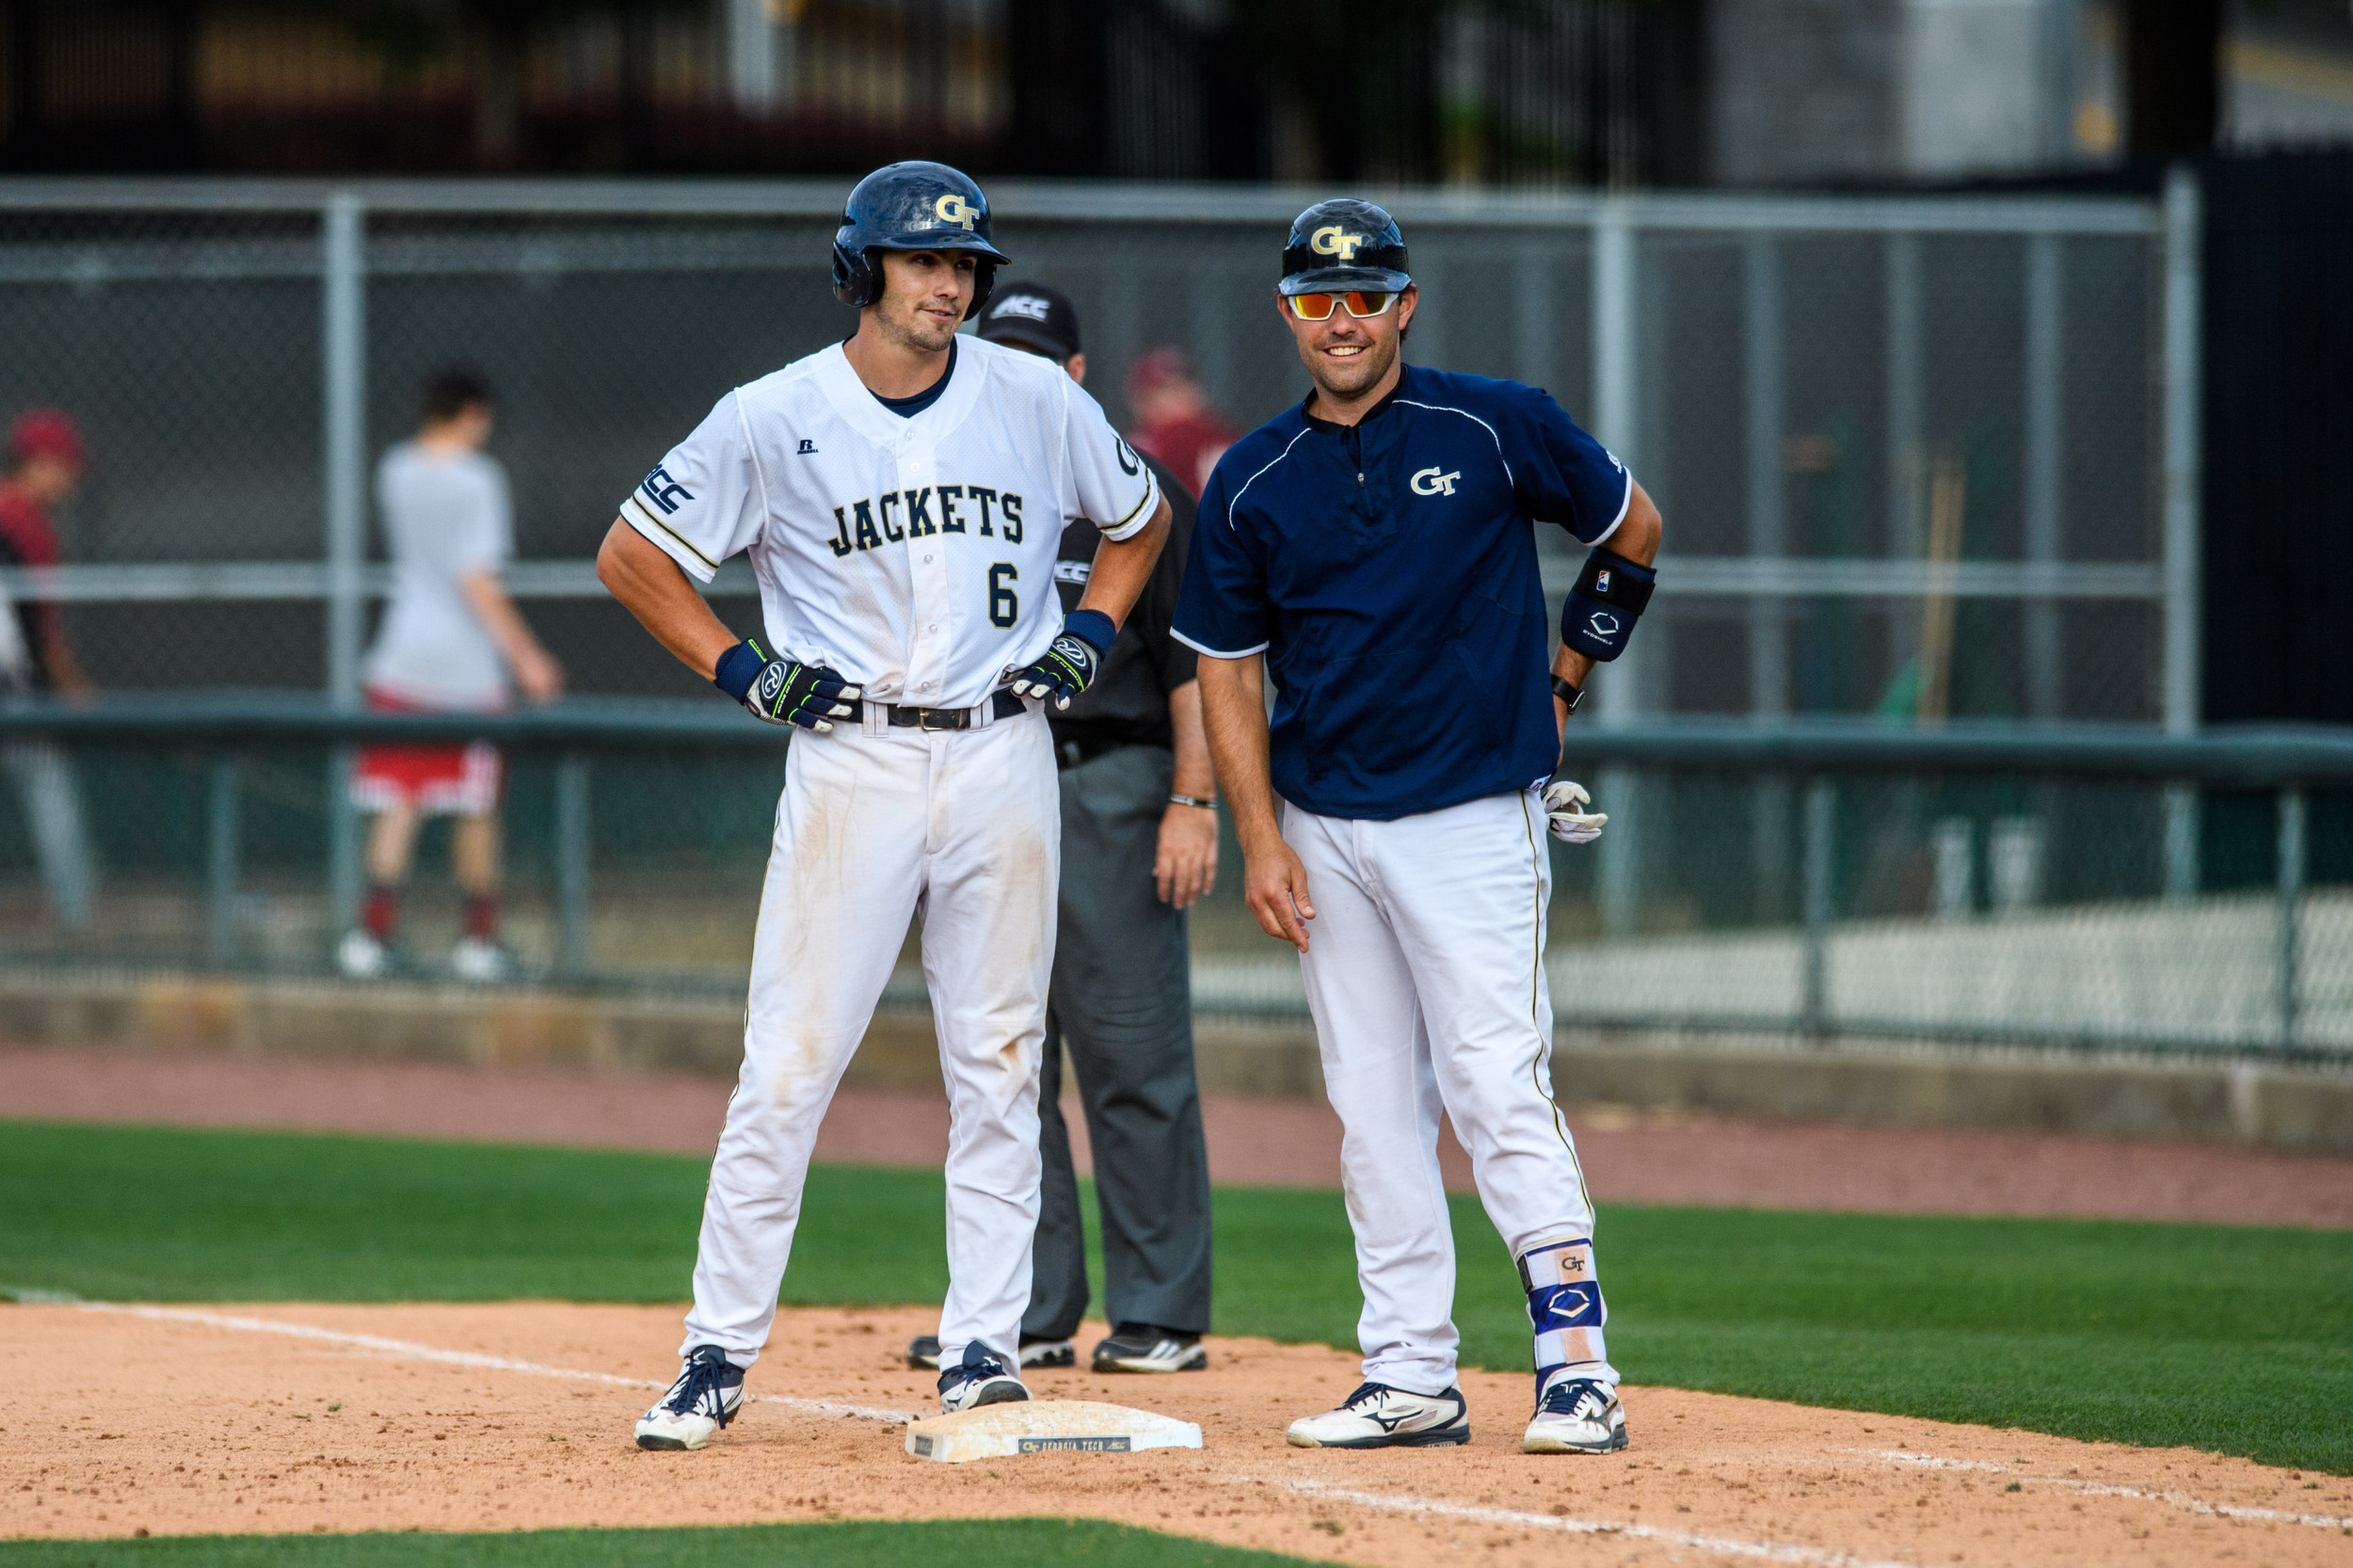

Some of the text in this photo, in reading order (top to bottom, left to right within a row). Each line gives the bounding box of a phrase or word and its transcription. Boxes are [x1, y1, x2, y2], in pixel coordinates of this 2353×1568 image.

[936, 194, 980, 231] GT
[1311, 226, 1362, 260] GT
[990, 295, 1051, 323] ACC
[1410, 467, 1461, 496] GT
[827, 485, 1023, 558] JACKETS
[1054, 559, 1092, 584] CC
[987, 561, 1018, 631] 6
[1561, 1256, 1585, 1272] GT
[1042, 1441, 1078, 1451] GEORGIA
[1082, 1441, 1103, 1451] TECH
